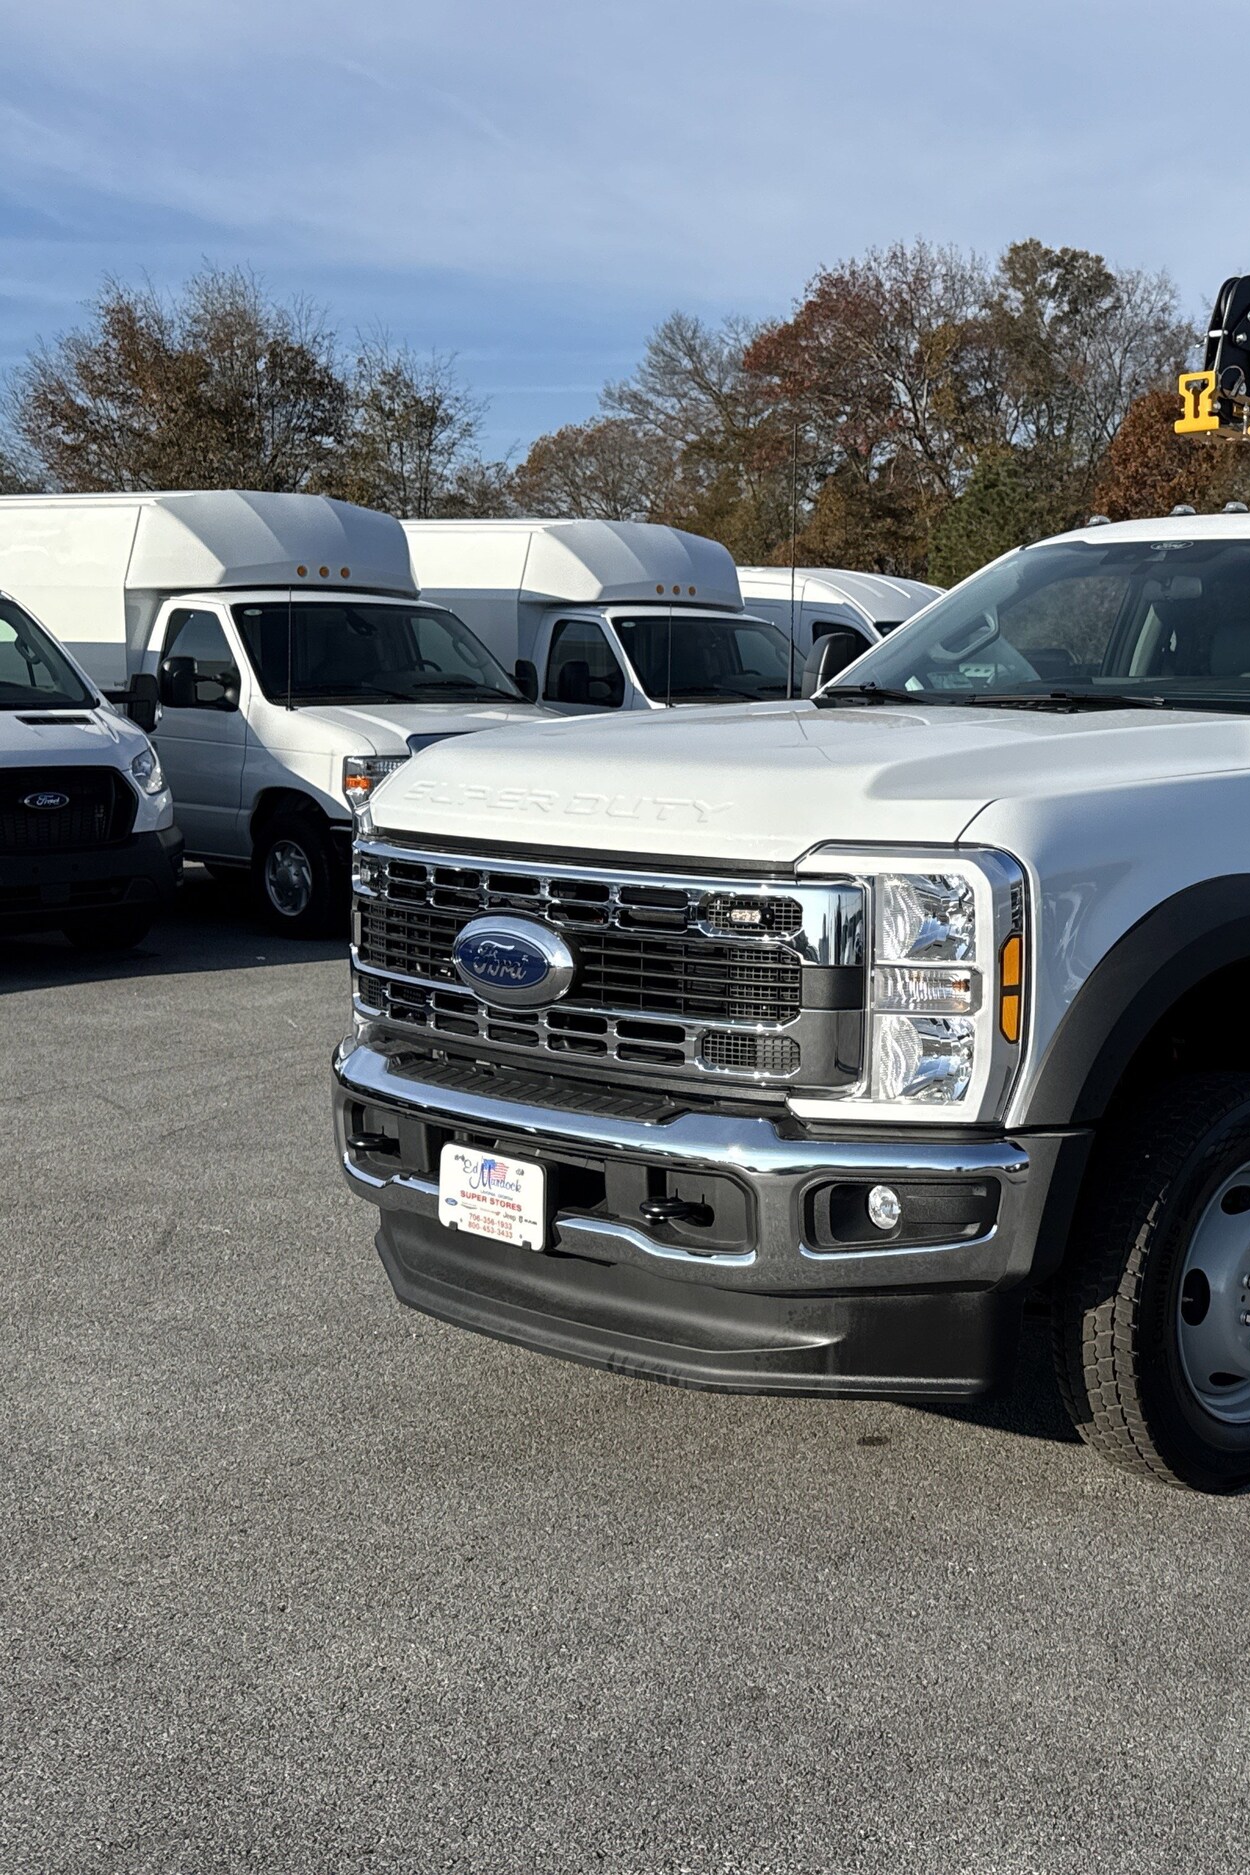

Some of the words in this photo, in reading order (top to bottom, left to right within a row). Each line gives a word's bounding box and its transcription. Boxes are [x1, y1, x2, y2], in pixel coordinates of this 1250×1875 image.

[403, 780, 560, 814] SUPER
[563, 793, 735, 823] DUTY
[472, 940, 529, 981] Ford
[462, 1158, 479, 1174] Ed
[468, 1161, 522, 1193] Murdock
[460, 1190, 488, 1203] SUPER
[490, 1198, 522, 1212] STORES
[467, 1220, 513, 1240] 800-453-3433
[469, 1212, 513, 1231] 706-356-1933
